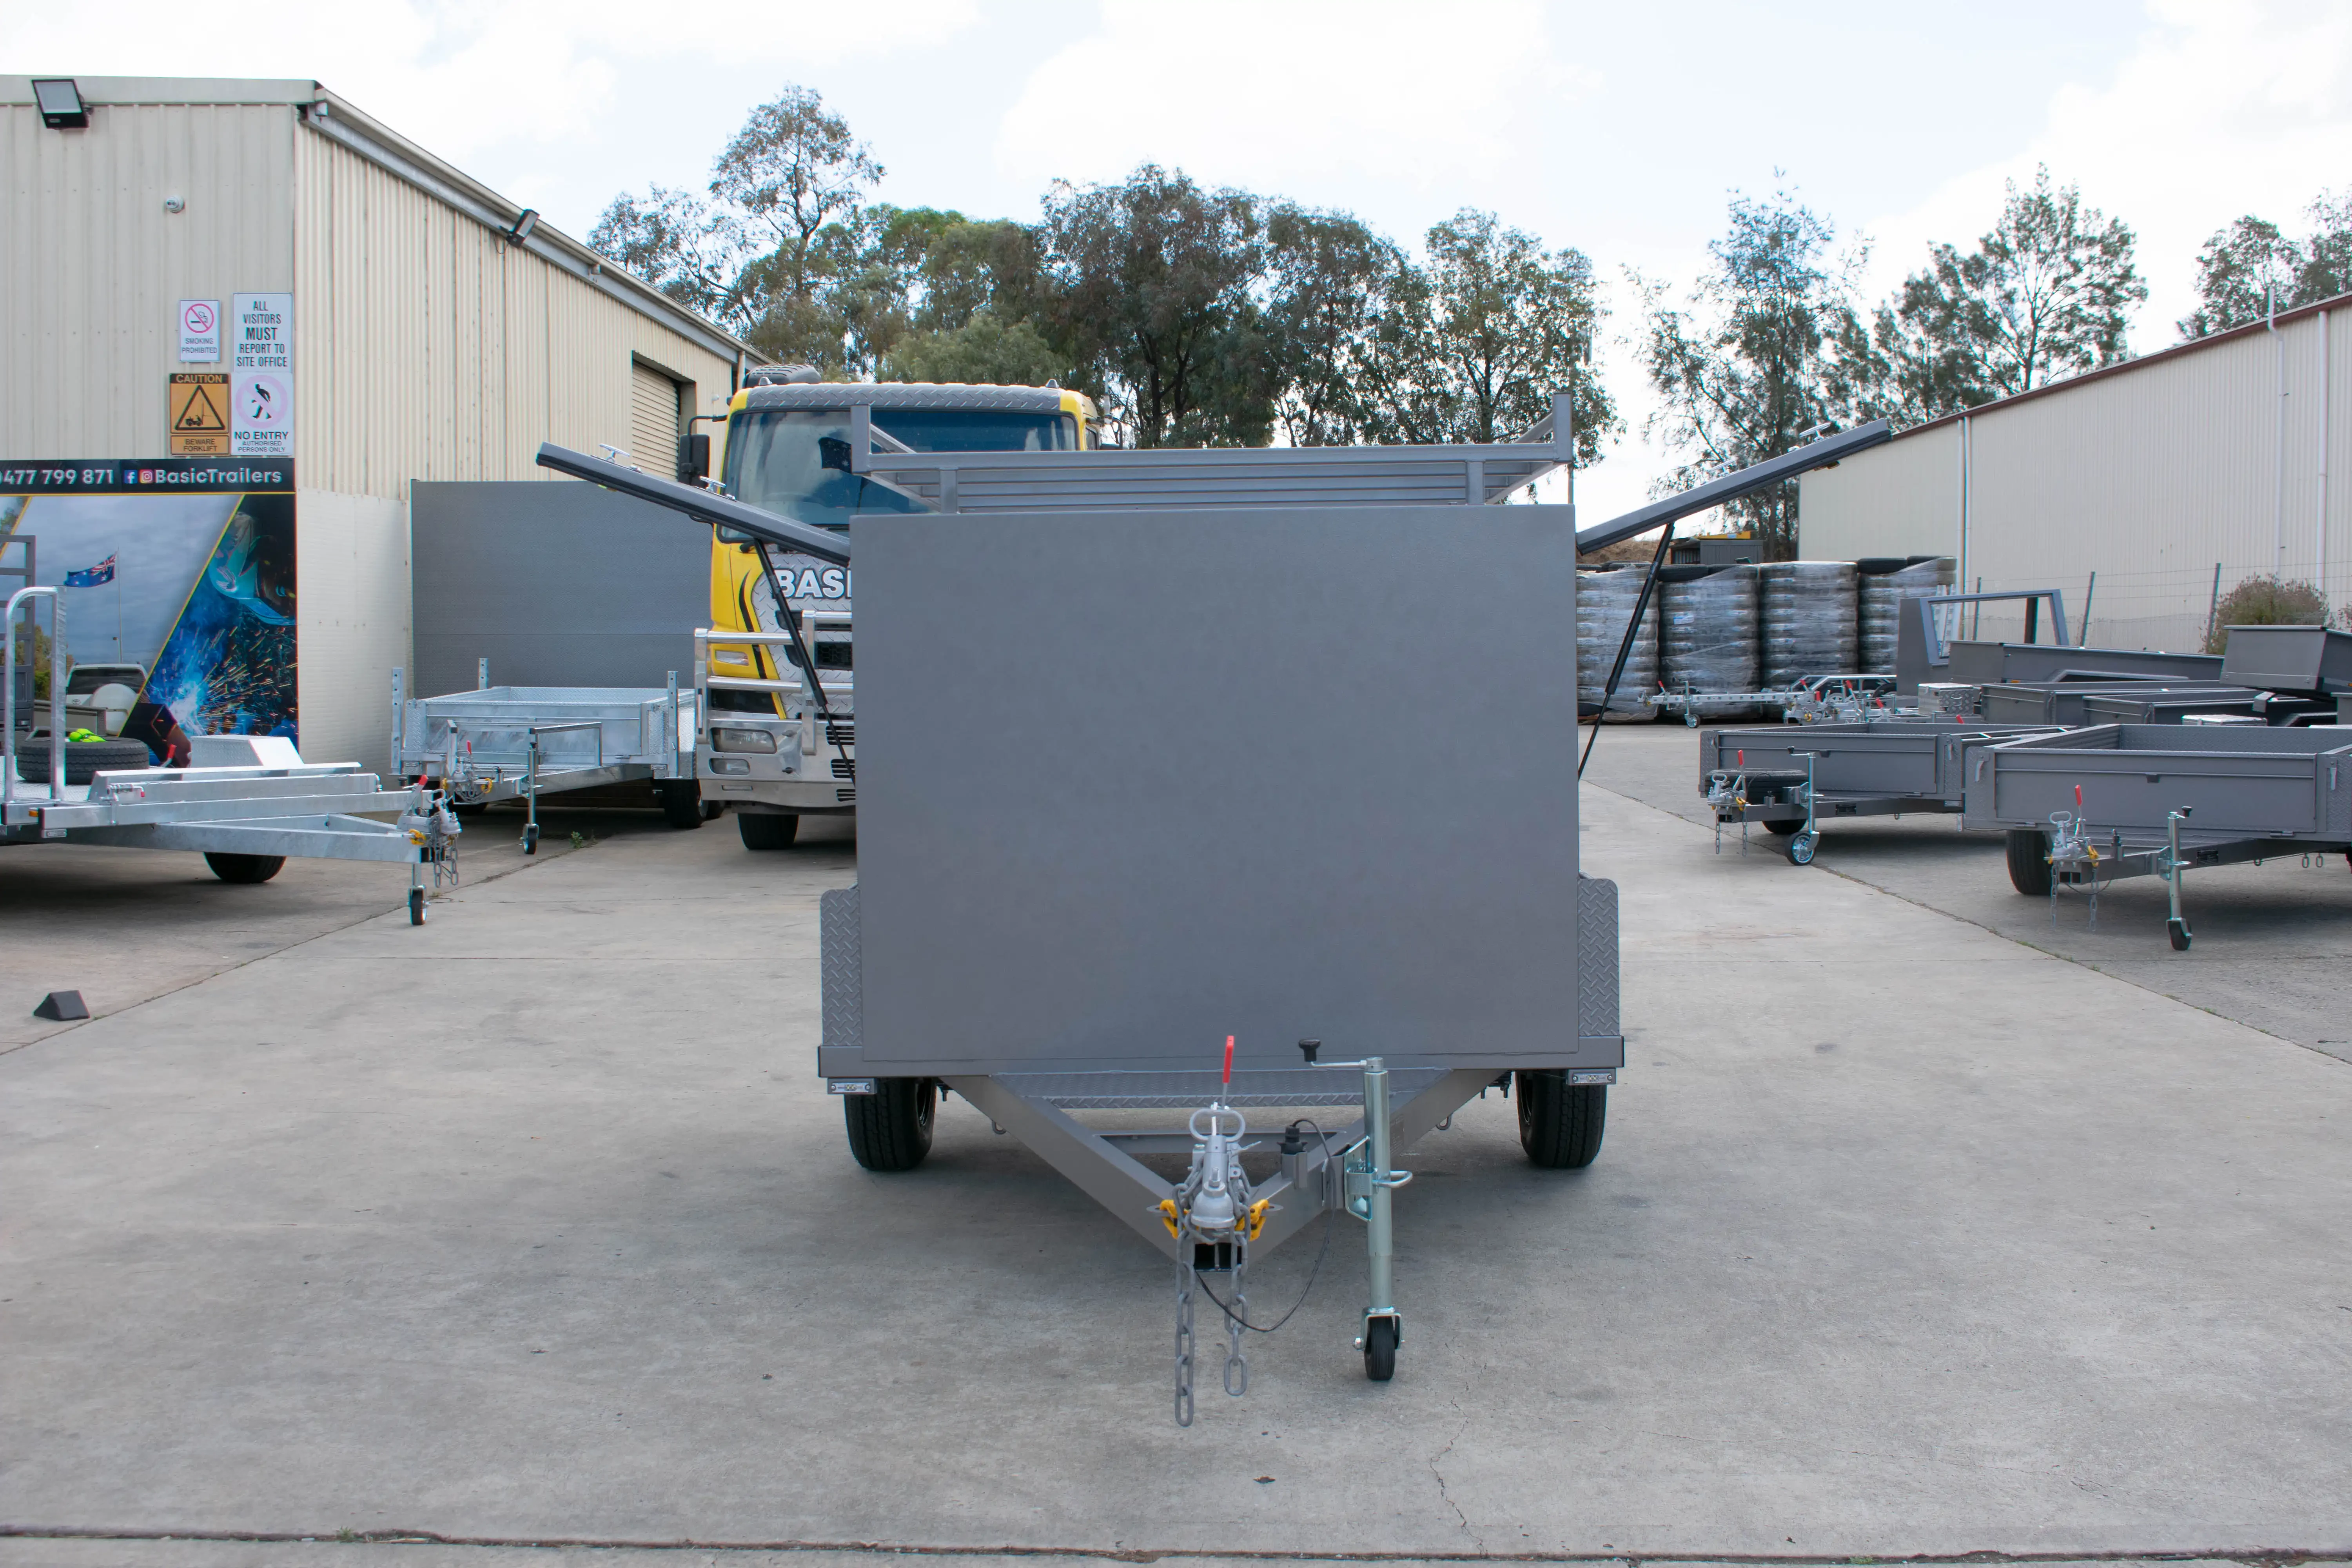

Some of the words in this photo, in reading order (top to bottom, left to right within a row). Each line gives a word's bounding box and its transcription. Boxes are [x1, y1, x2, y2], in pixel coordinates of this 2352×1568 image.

[254, 301, 268, 311] ALL
[243, 314, 281, 324] VISITORS
[246, 327, 278, 340] MUST
[240, 344, 271, 354] REPORT
[274, 344, 285, 353] TO
[237, 357, 255, 367] SITE
[259, 357, 288, 367] OFFICE
[176, 375, 223, 383] CAUTION
[235, 432, 250, 440] NO
[254, 432, 289, 440] ENTRY
[0, 470, 38, 485] 477
[42, 470, 77, 485] 799
[82, 469, 114, 485] 871
[155, 468, 283, 484] BasicTrailers
